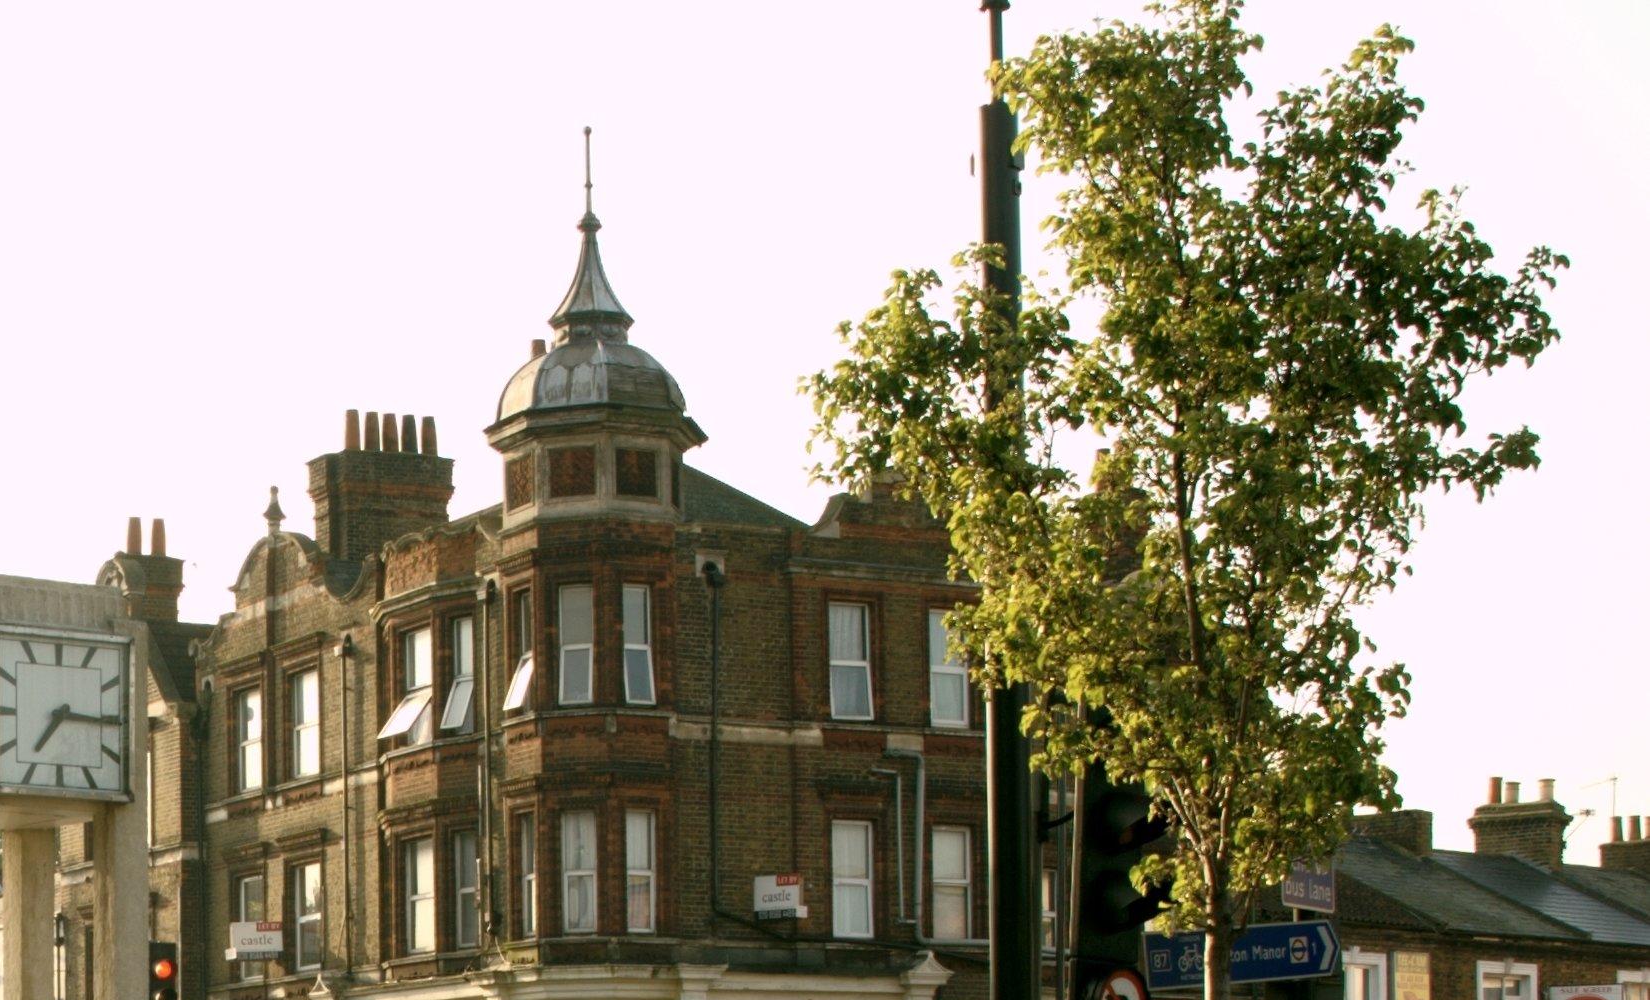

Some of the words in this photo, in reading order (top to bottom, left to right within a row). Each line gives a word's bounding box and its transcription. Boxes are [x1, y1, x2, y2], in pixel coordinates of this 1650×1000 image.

[761, 889, 792, 903] castle
[1308, 879, 1331, 901] lane
[240, 934, 274, 946] castle
[1251, 944, 1287, 961] Manor
[1153, 953, 1168, 968] 87
